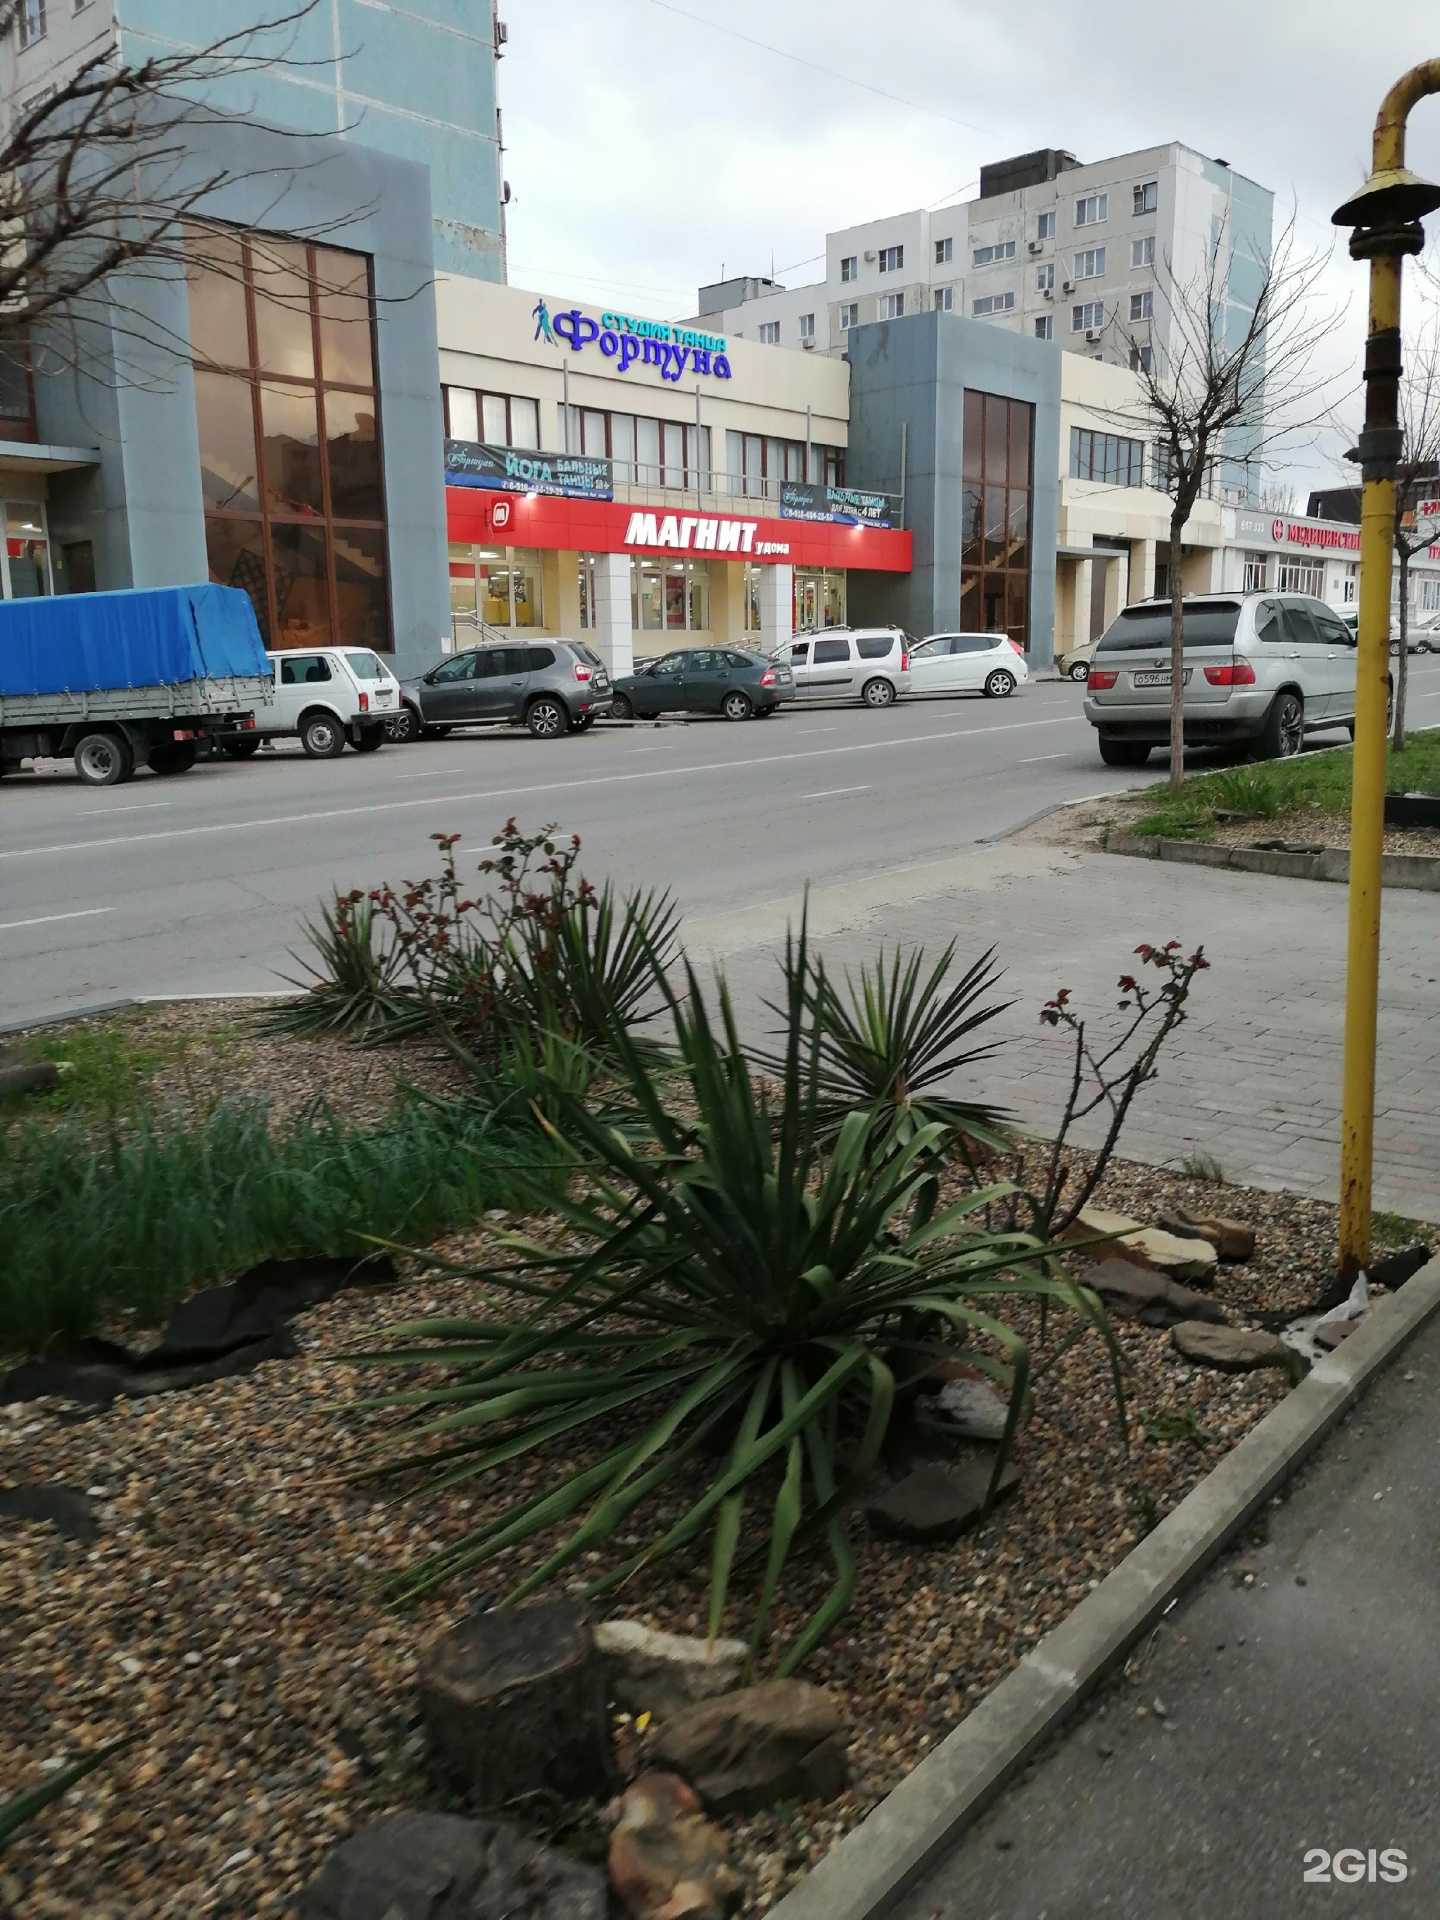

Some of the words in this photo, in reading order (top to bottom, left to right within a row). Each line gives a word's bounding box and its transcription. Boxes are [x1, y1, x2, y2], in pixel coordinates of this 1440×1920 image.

[602, 311, 670, 341] СТУДИЯ
[552, 310, 732, 382] Фортуна
[505, 451, 553, 482] ЙОГА
[557, 459, 608, 476] БАЛЬНЫЕ
[559, 473, 594, 489] ТАНЦЫ
[624, 512, 758, 552] МАГНИТ
[1288, 523, 1361, 551] МЕДИЦИНСКИ
